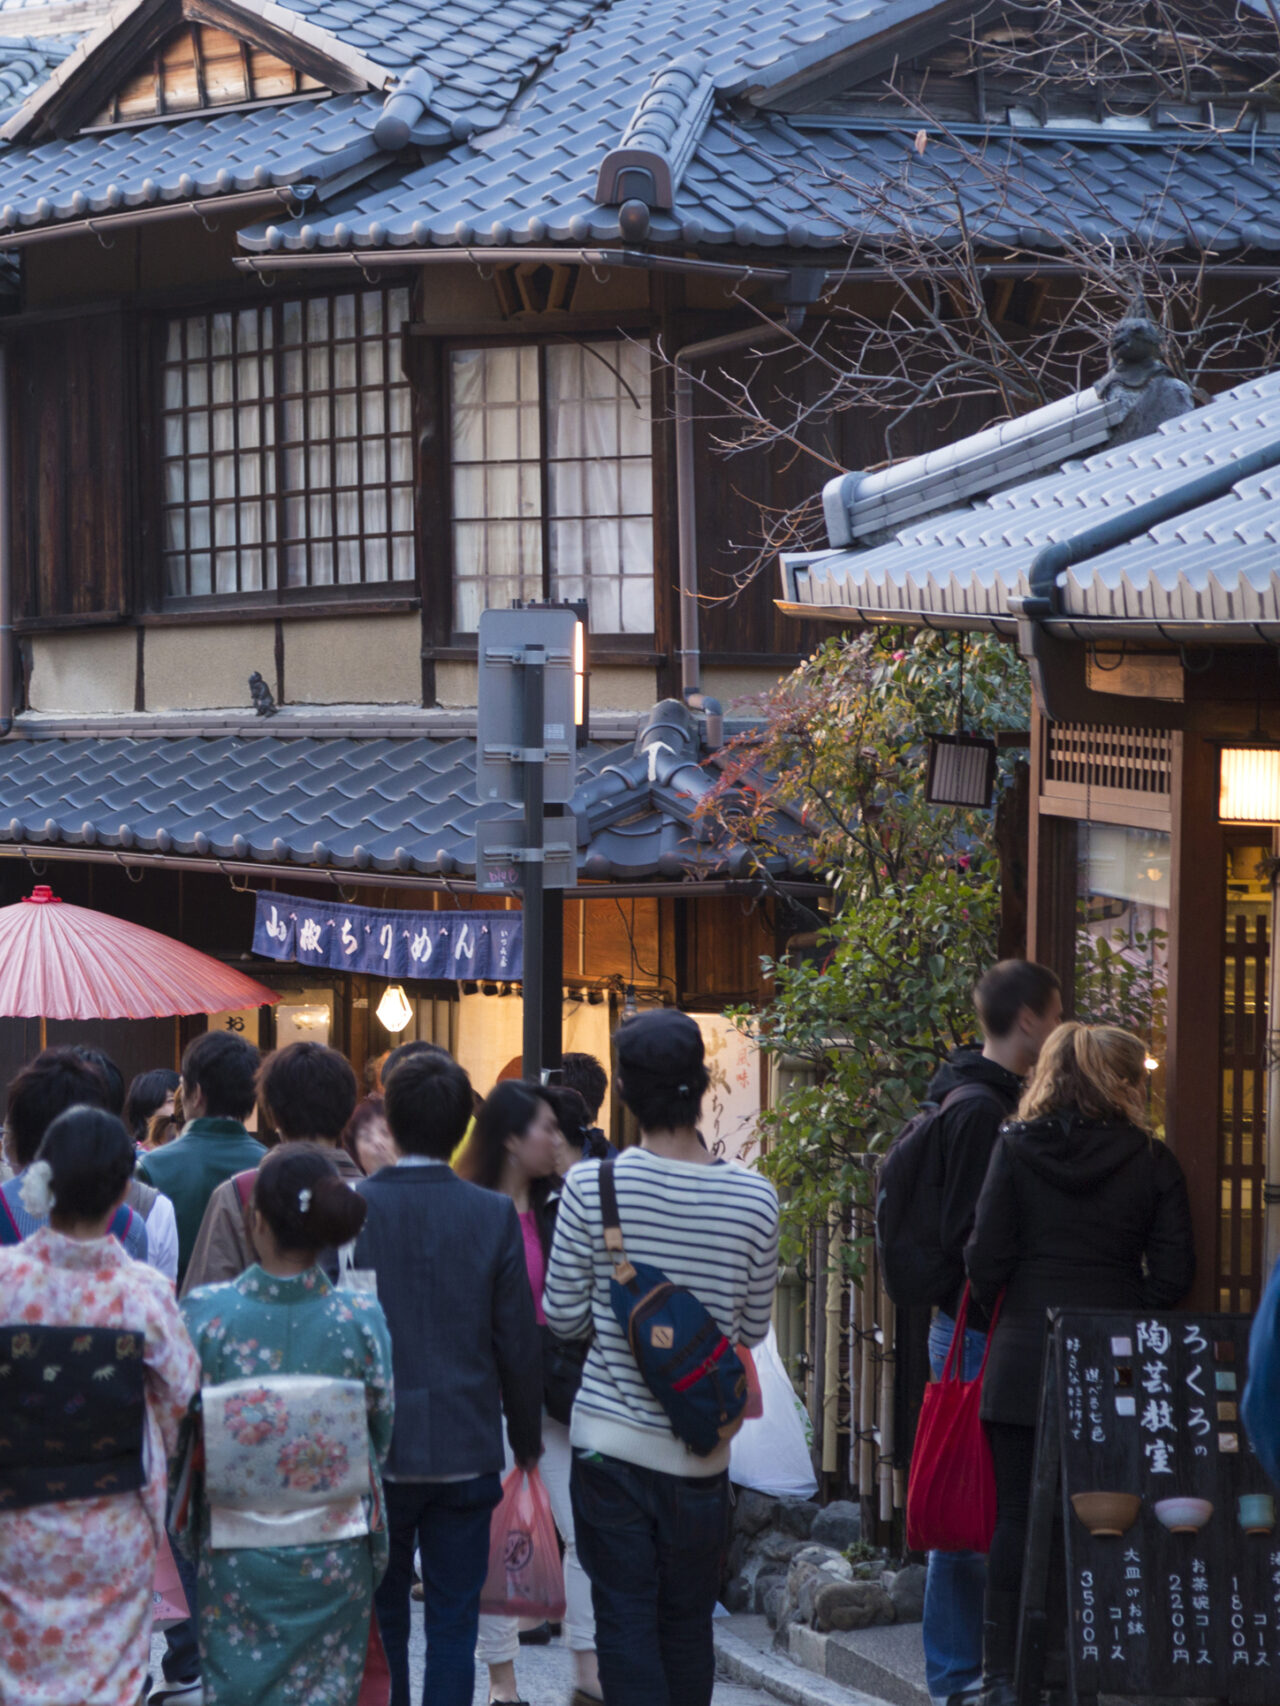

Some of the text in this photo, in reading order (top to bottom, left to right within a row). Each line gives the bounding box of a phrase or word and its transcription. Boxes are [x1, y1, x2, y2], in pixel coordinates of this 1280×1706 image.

[265, 905, 476, 963] 山椒ちりめん
[226, 1015, 246, 1032] お
[1135, 1318, 1179, 1475] 陶芸教室
[1182, 1324, 1212, 1457] ろくろの
[1080, 1570, 1100, 1662] 3500円
[1109, 1606, 1126, 1661] コース
[1168, 1573, 1190, 1665] 2200円
[1191, 1557, 1213, 1665] お茶碗コース
[1230, 1575, 1250, 1666] 1800円
[1253, 1612, 1271, 1667] コース
